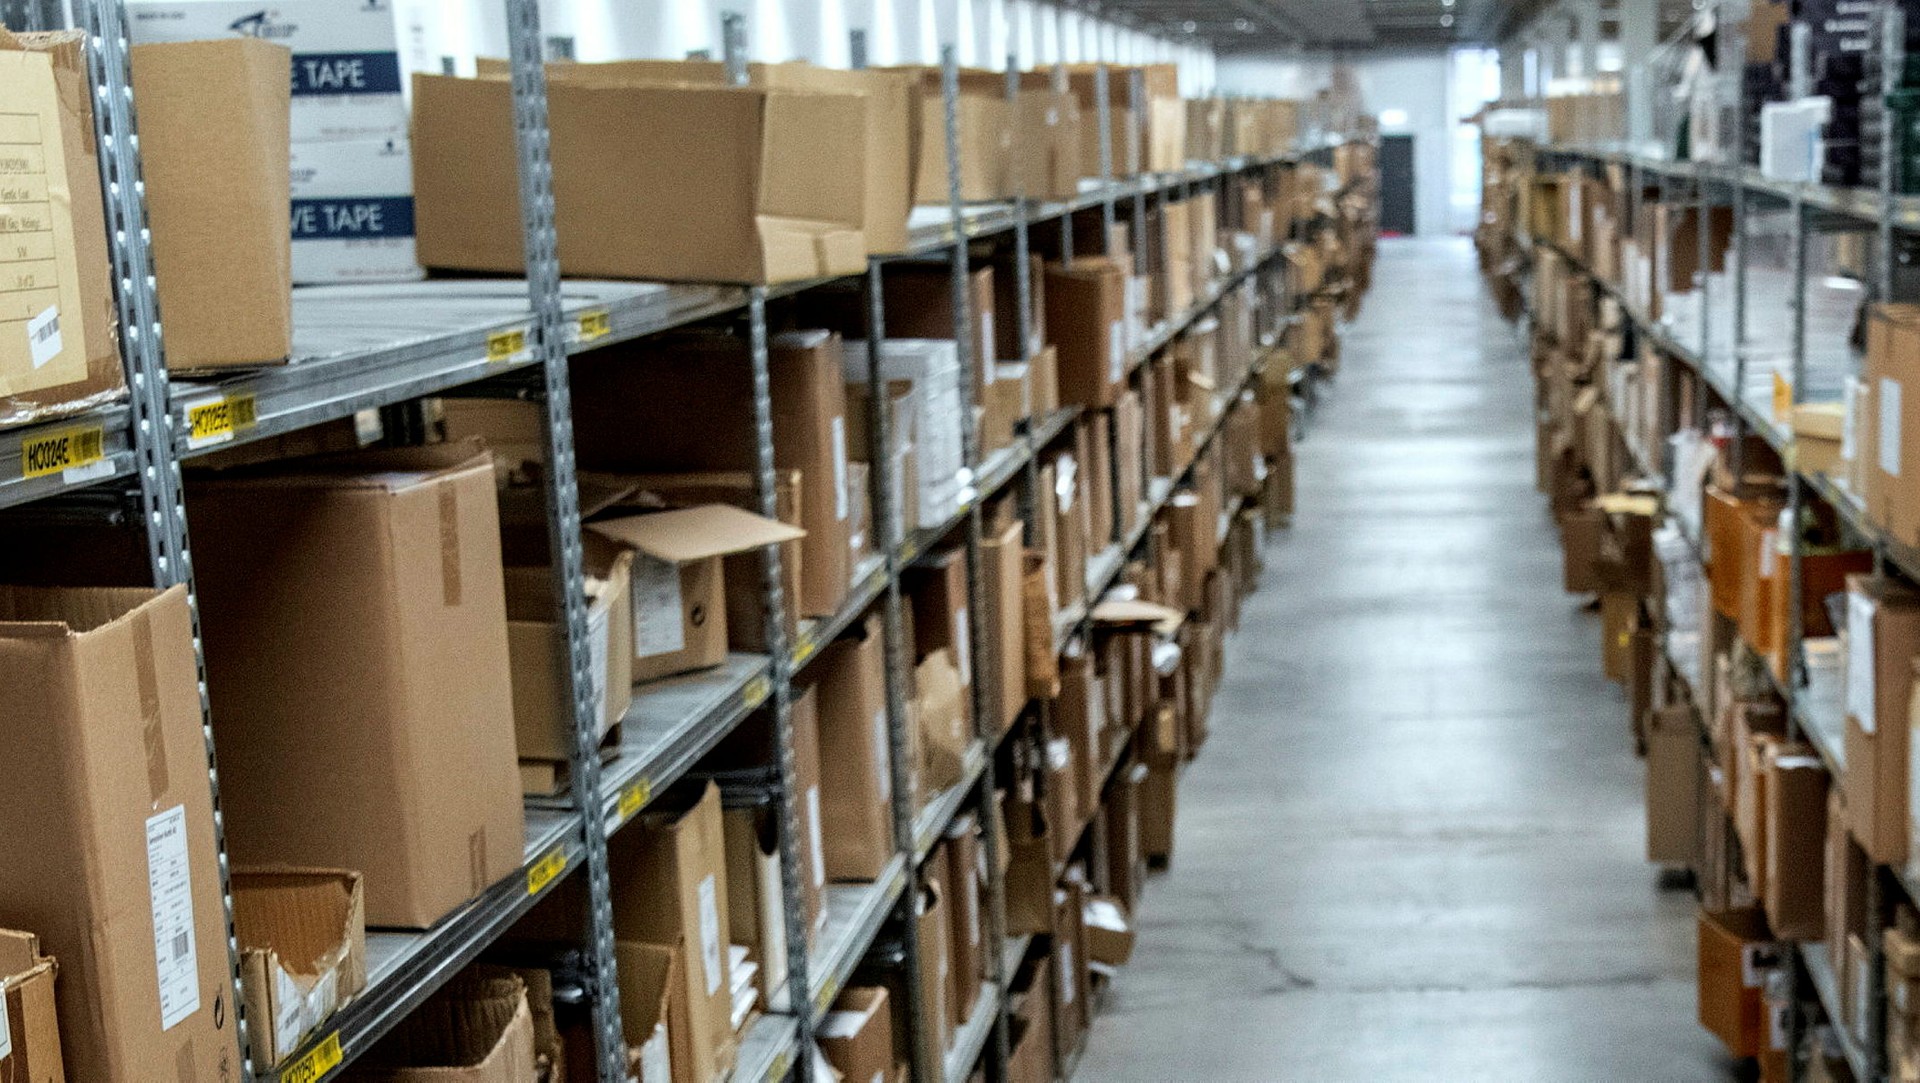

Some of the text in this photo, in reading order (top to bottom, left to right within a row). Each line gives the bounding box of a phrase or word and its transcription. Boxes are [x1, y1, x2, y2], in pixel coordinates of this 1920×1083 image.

[302, 60, 366, 89] TAPE
[322, 203, 384, 232] TAPE
[28, 437, 71, 472] HC024E
